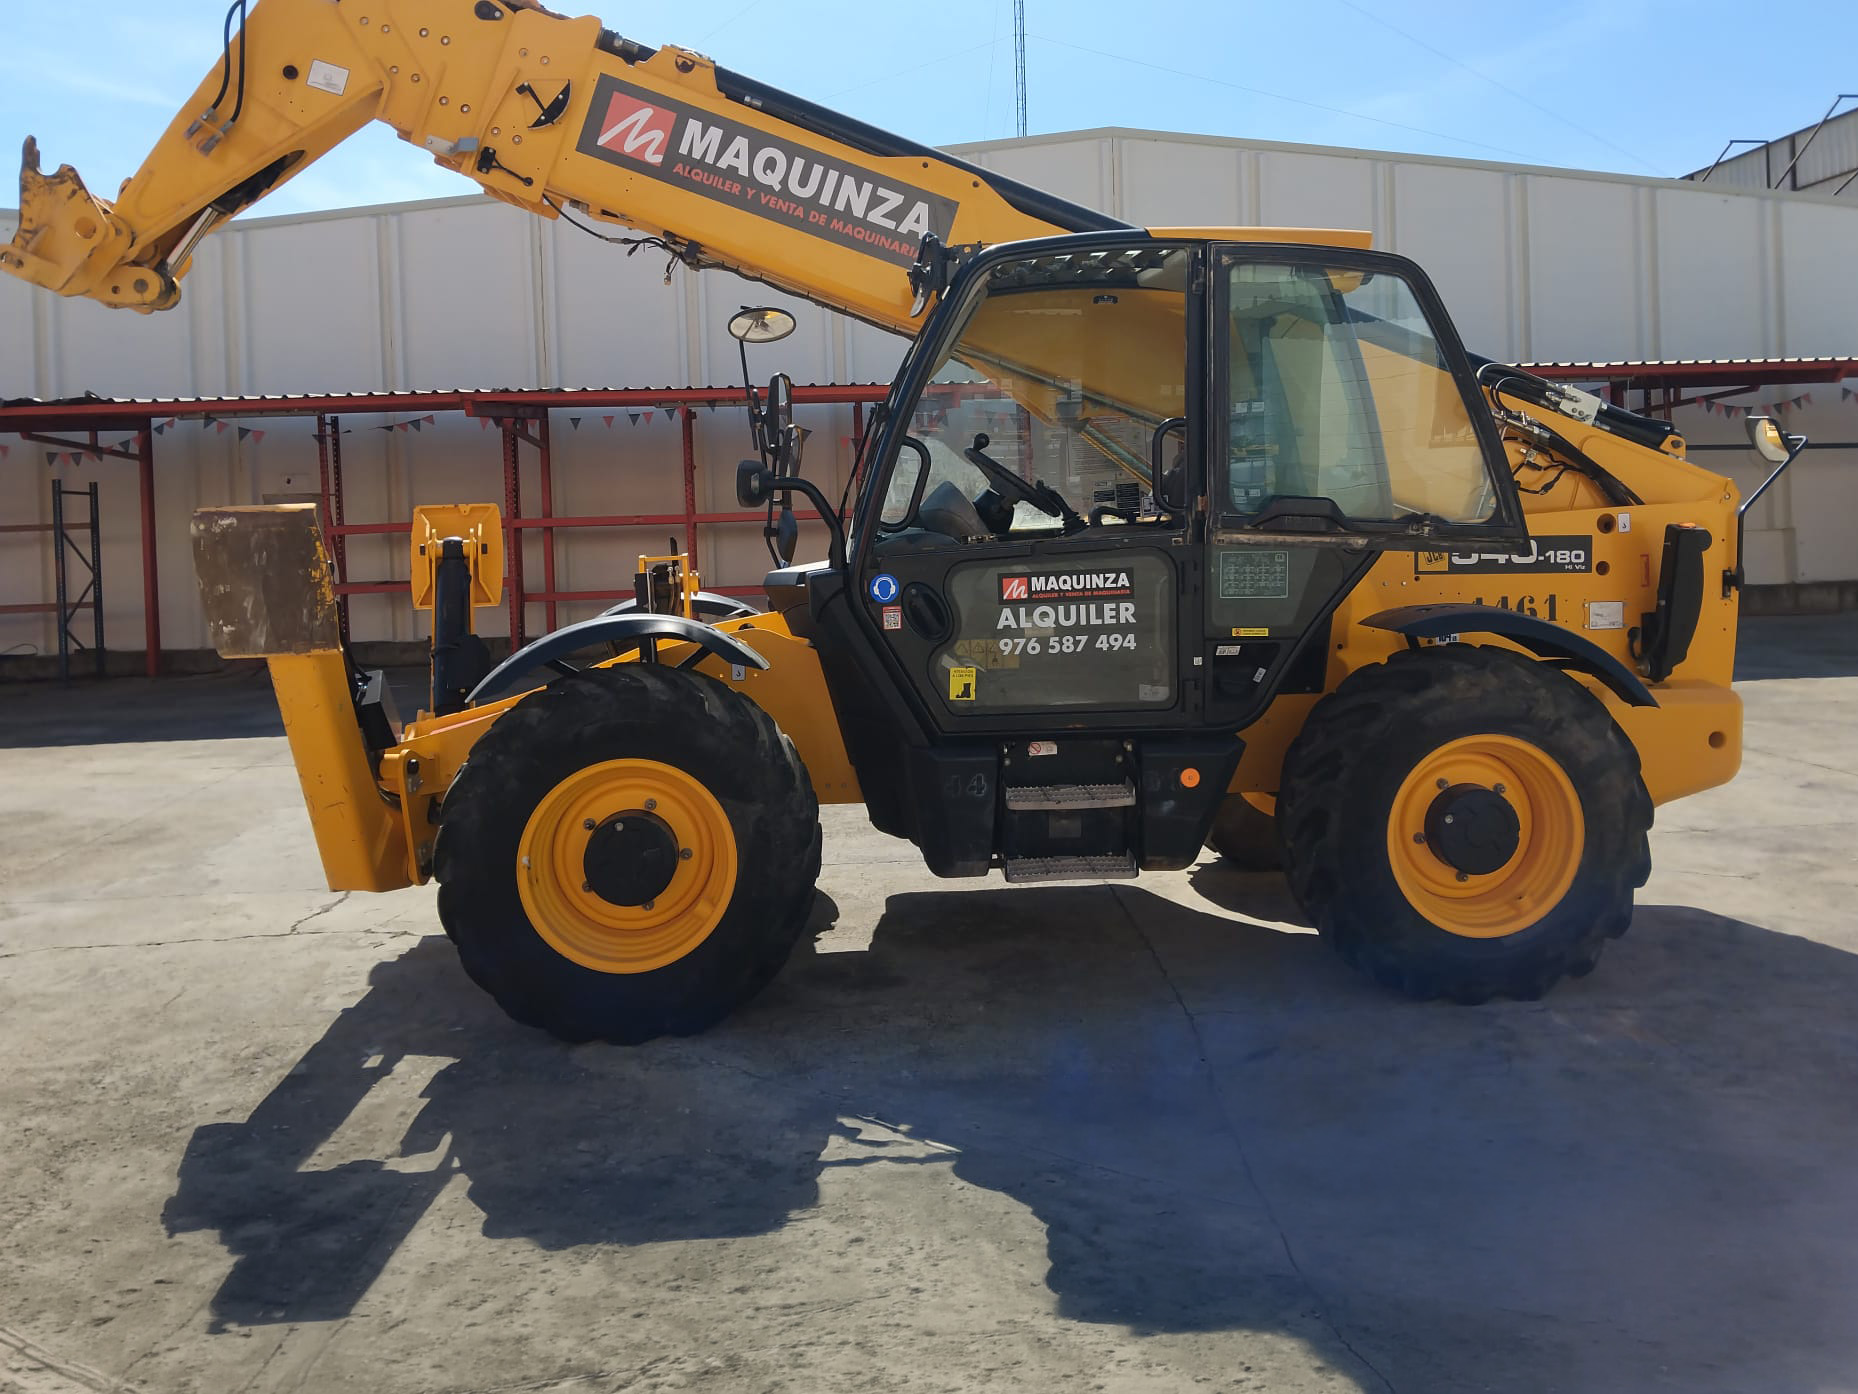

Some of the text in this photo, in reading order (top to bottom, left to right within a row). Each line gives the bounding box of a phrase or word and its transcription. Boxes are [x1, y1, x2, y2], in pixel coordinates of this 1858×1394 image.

[679, 118, 929, 240] MAQUINZA
[673, 163, 741, 196] ALQUILER
[746, 187, 757, 200] Y
[760, 193, 804, 219] VENTA
[809, 210, 828, 226] DE
[1031, 573, 1130, 591] MAQUINZA
[997, 603, 1136, 629] ALQUILER
[1471, 594, 1556, 621] 461
[1000, 633, 1136, 655] 976 587 494
